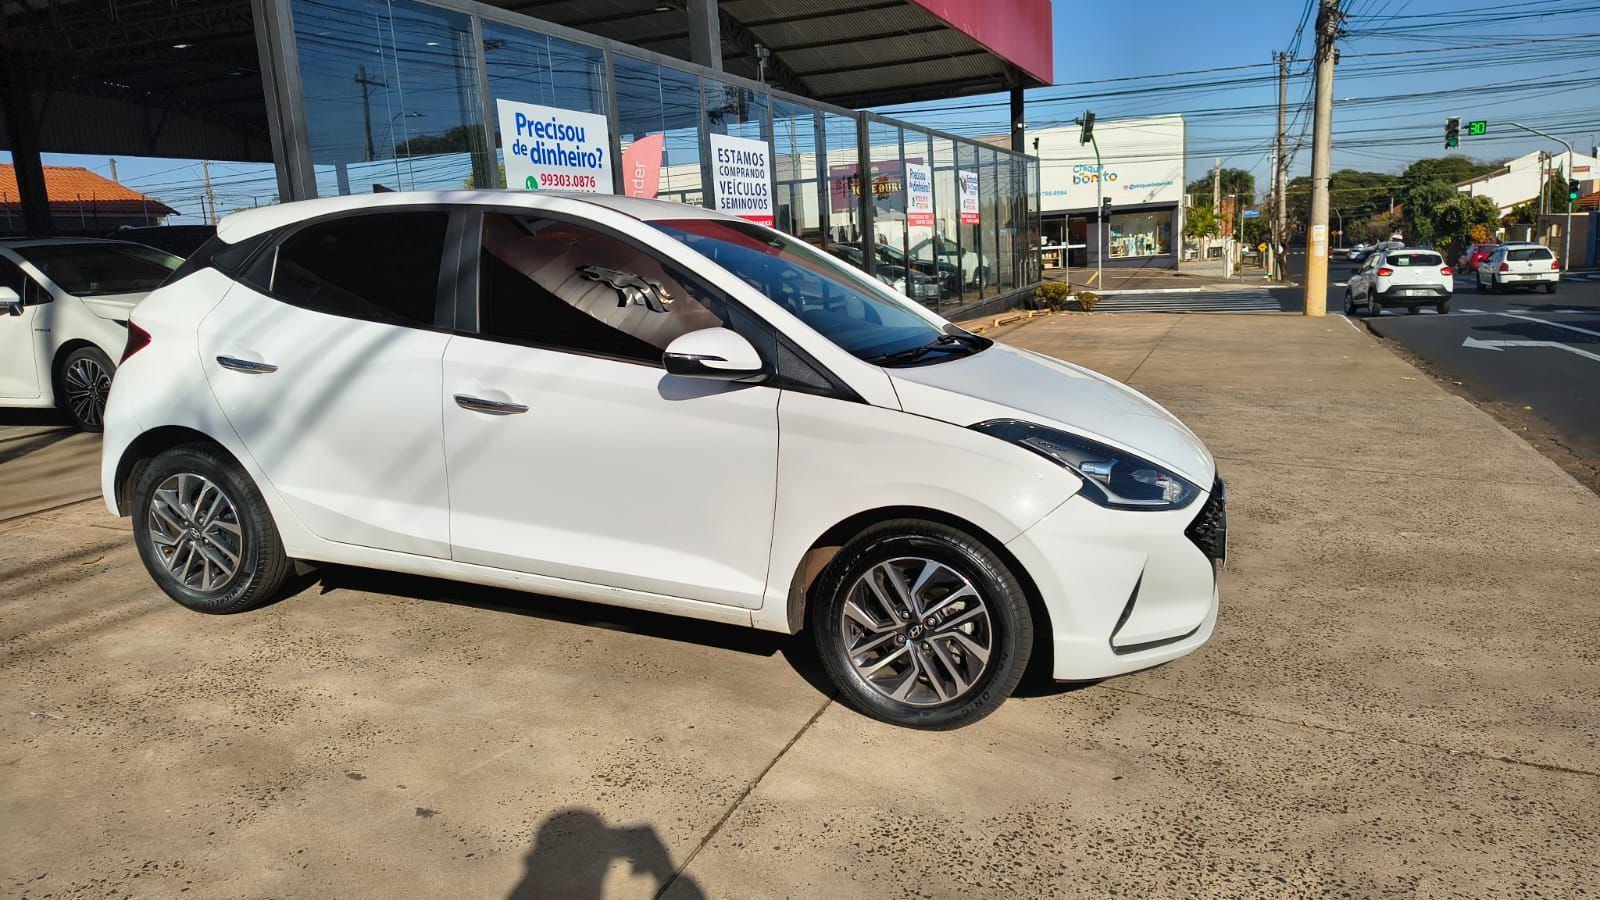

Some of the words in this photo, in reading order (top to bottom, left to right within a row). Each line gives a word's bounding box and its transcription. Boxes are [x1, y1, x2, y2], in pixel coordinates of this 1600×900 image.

[515, 112, 585, 143] Precisou
[1469, 122, 1485, 135] 30
[512, 139, 528, 156] de
[530, 140, 603, 169] dinheiro?
[717, 147, 765, 167] ESTAMOS
[719, 165, 765, 179] COMPRANDO
[1073, 171, 1118, 185] bonto
[540, 173, 596, 188] 99303.0876
[719, 178, 767, 197] VEÍCULOS
[721, 197, 768, 210] SEMINOVOS
